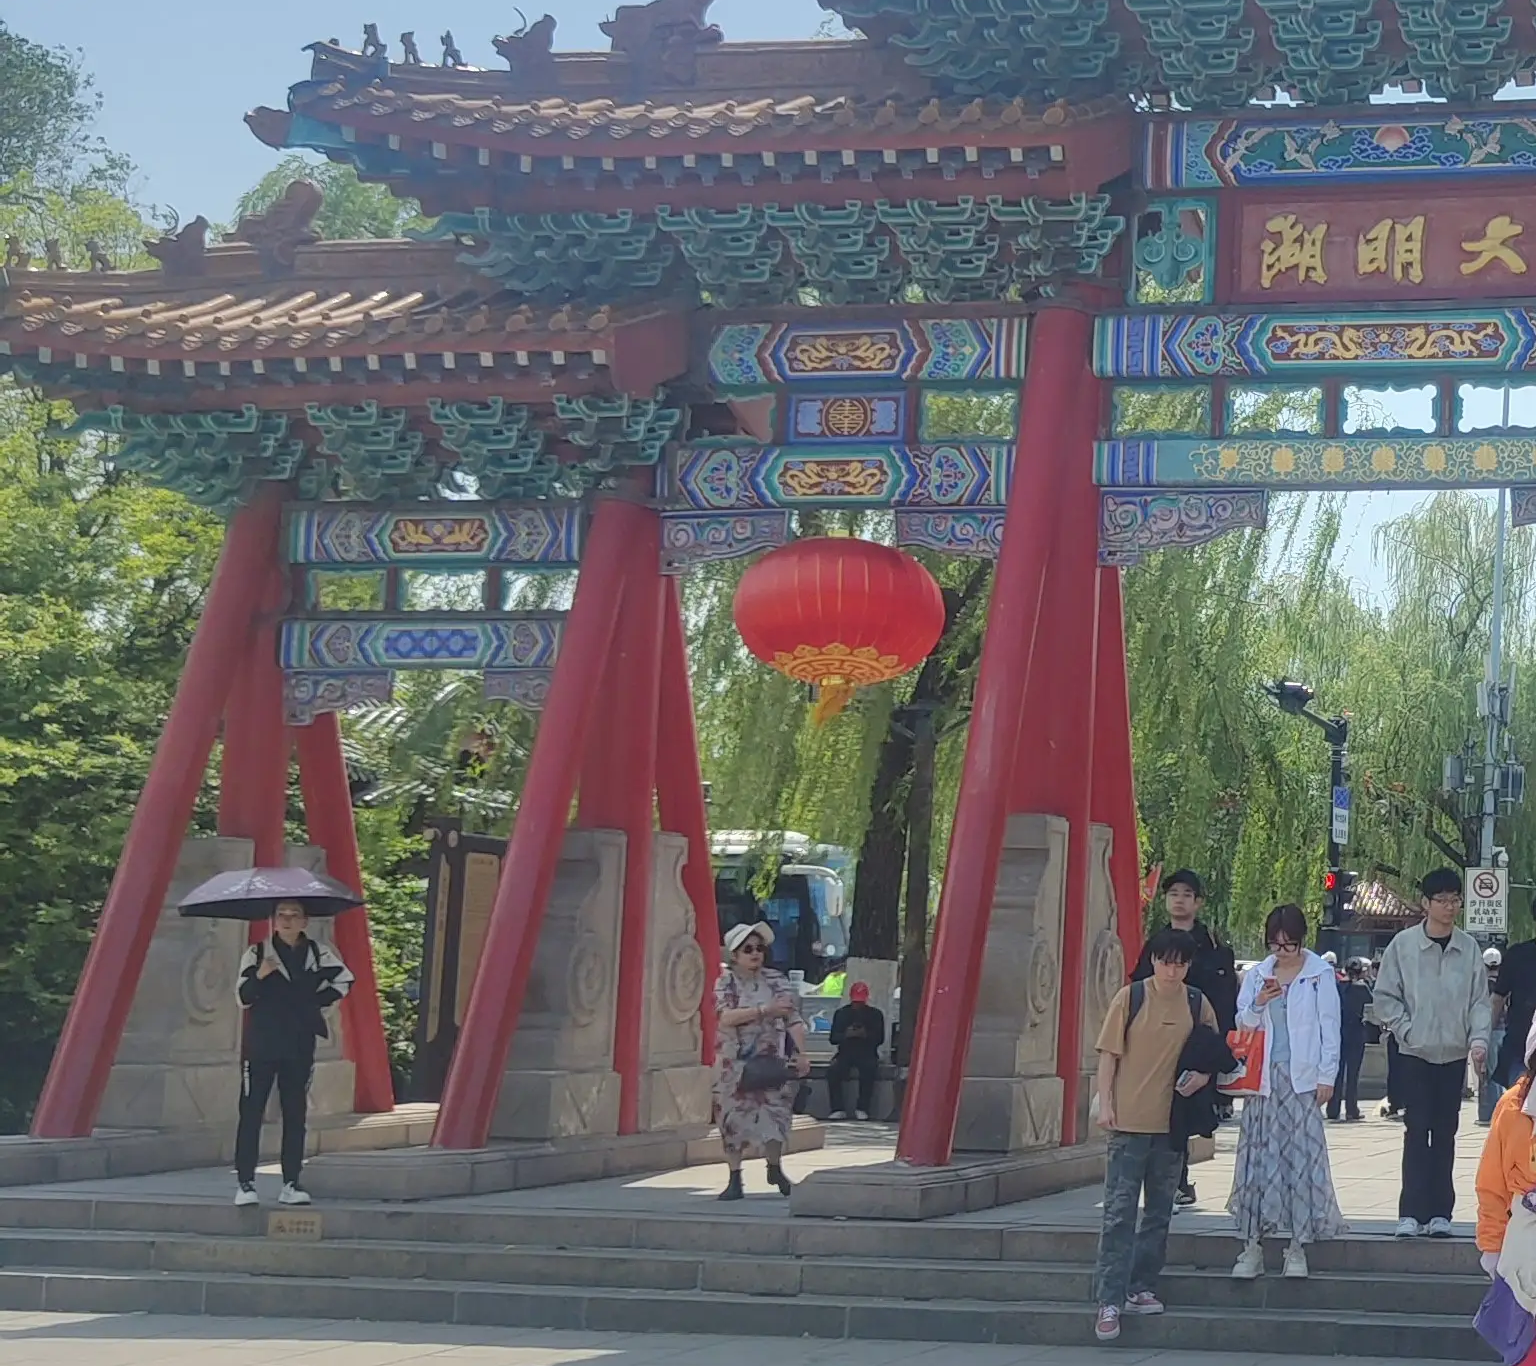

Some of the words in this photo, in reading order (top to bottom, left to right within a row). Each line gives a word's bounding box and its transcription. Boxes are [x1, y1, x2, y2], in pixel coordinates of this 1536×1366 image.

[1260, 214, 1528, 289] 大明湖
[1469, 899, 1503, 908] 步行街区
[1474, 908, 1499, 916] 机动车
[1469, 916, 1503, 925] 禁止通行
